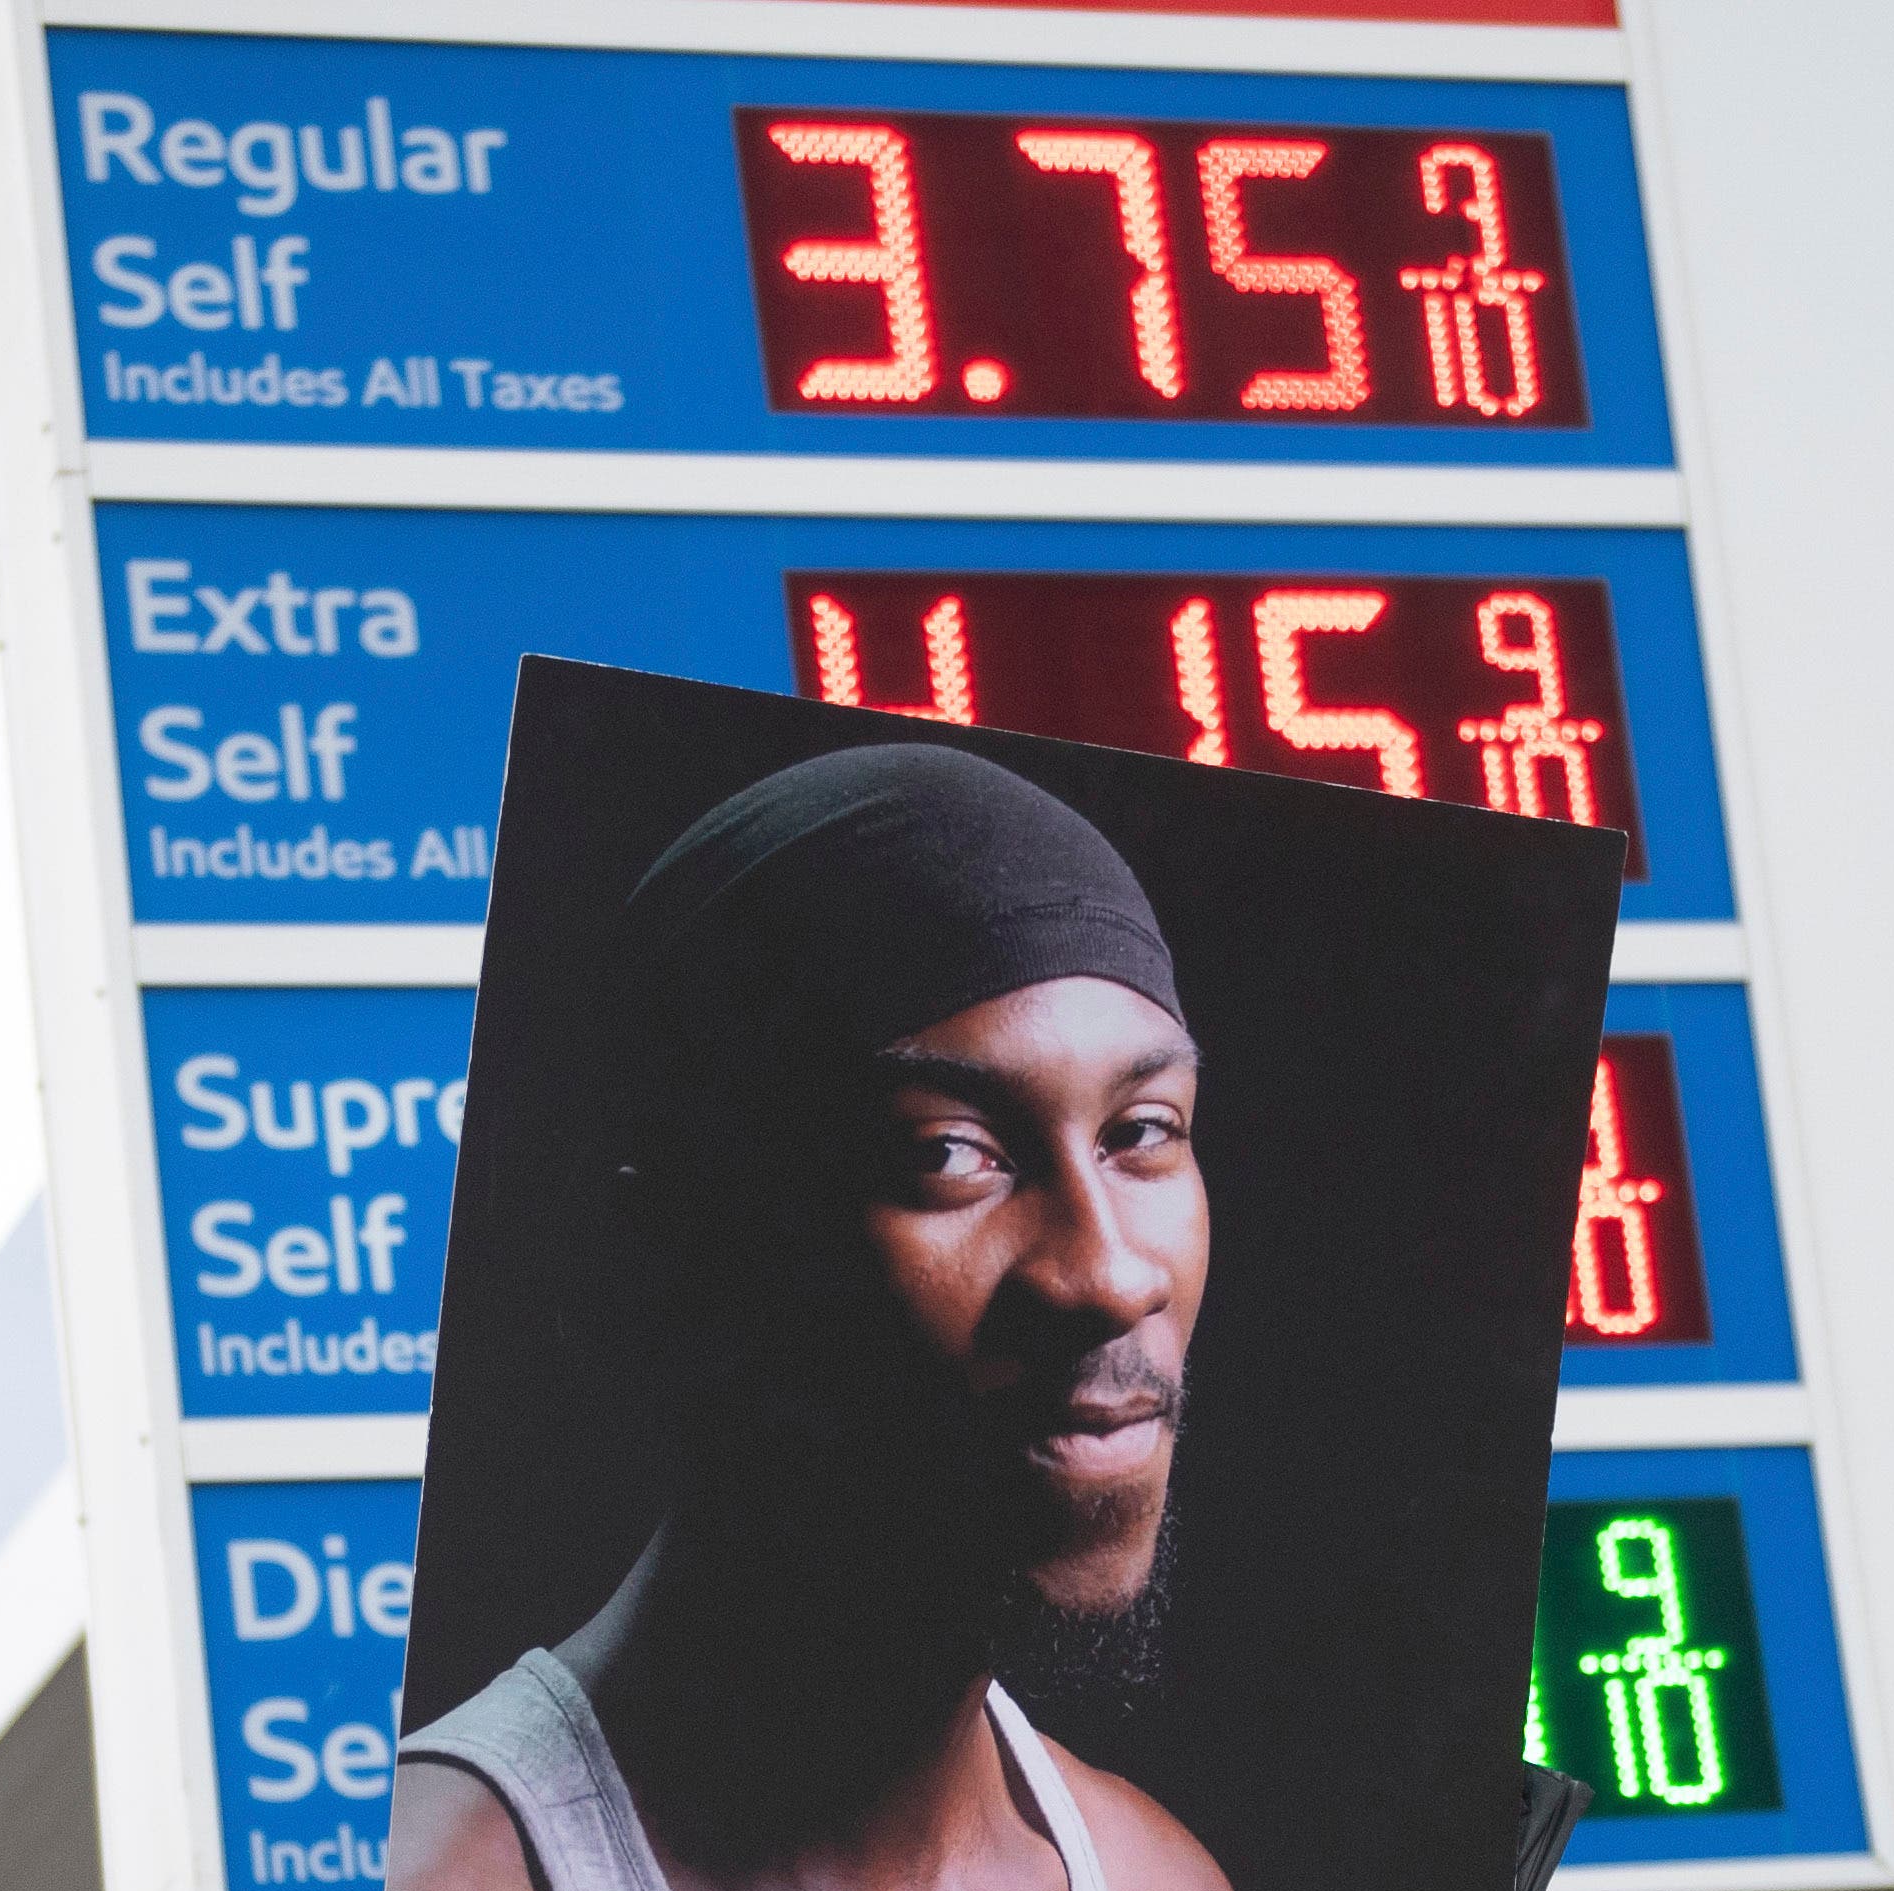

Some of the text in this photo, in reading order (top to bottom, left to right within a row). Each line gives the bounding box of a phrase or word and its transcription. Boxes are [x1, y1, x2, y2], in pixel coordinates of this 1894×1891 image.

[78, 91, 507, 217] Regular
[92, 234, 311, 331] Self
[769, 122, 1370, 412] 3.75
[104, 350, 625, 412] Includes All Taxes
[125, 558, 421, 658] Extra
[139, 702, 358, 802] Self
[149, 823, 491, 880] Includes All
[191, 1192, 406, 1297] Self
[197, 1315, 437, 1376] Includes
[226, 1533, 415, 1642] Die
[1596, 1516, 1685, 1656] 9
[1604, 1664, 1724, 1806] 10
